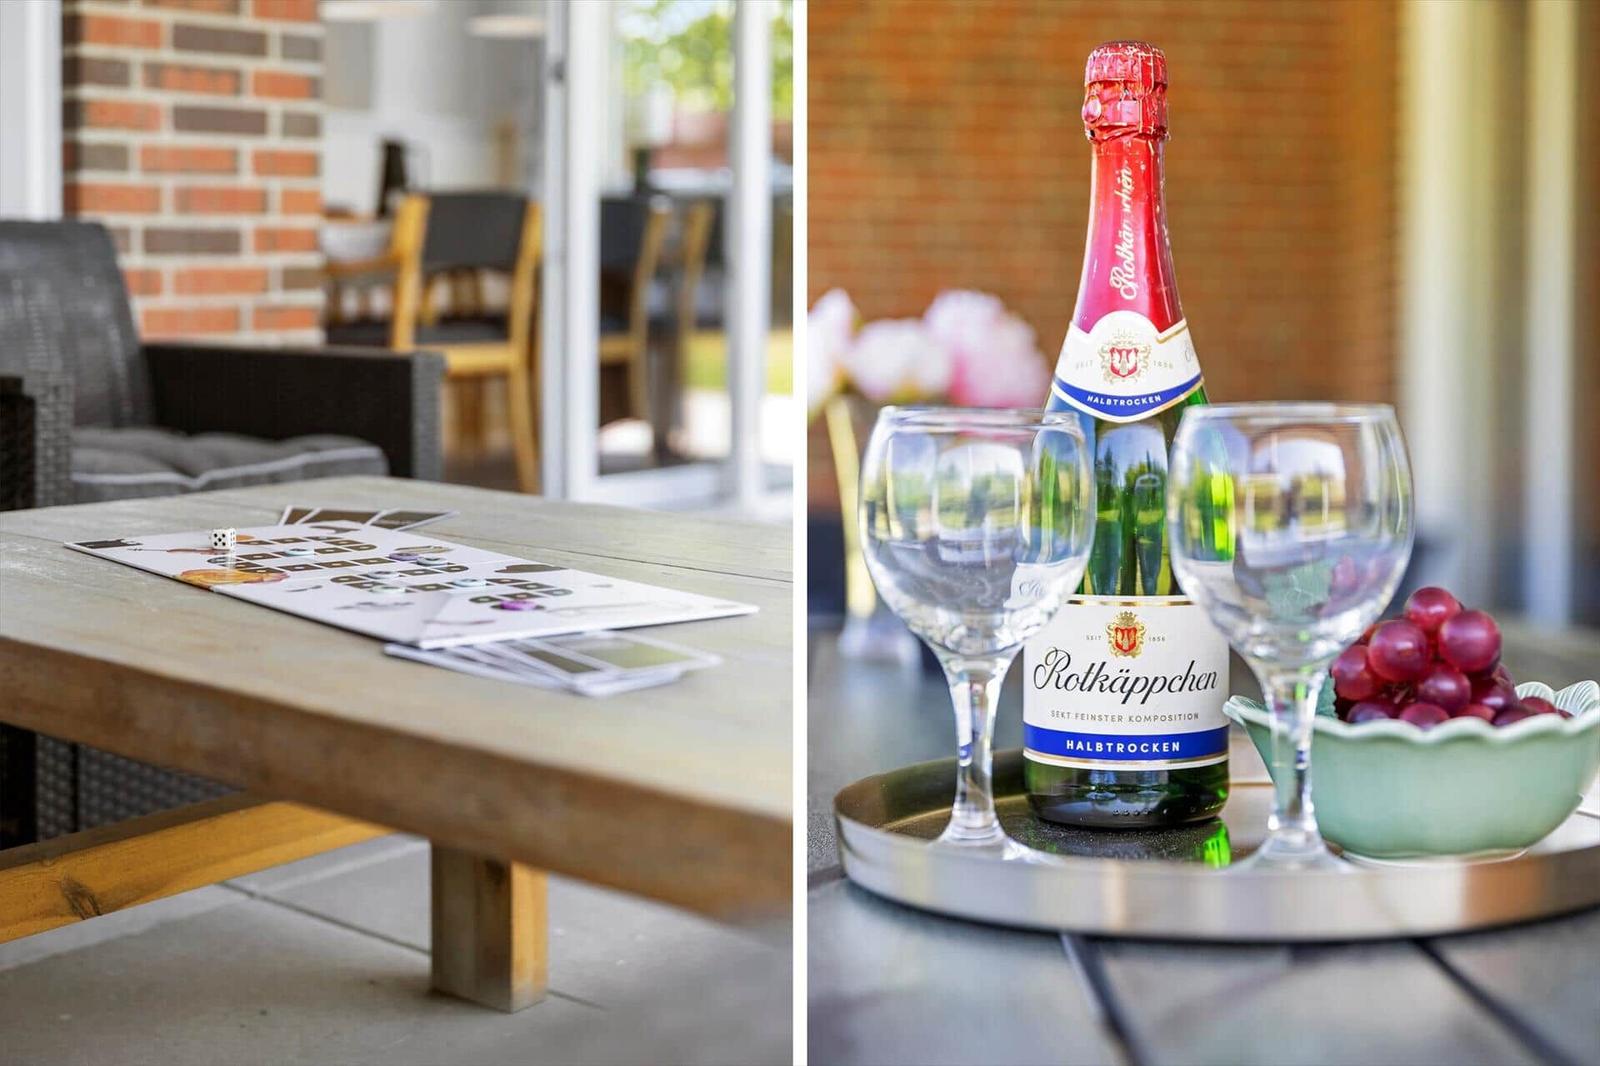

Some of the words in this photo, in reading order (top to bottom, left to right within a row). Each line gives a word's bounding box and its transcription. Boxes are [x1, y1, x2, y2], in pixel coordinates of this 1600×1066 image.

[1087, 395, 1161, 406] HALBTROCKEN
[1033, 647, 1217, 705] Rotkäppchen
[1050, 710, 1071, 720] SEKT
[1074, 713, 1123, 723] FEINSTER
[1128, 712, 1199, 723] KOMPOSITION
[1066, 740, 1180, 753] HALBTROCKEN
